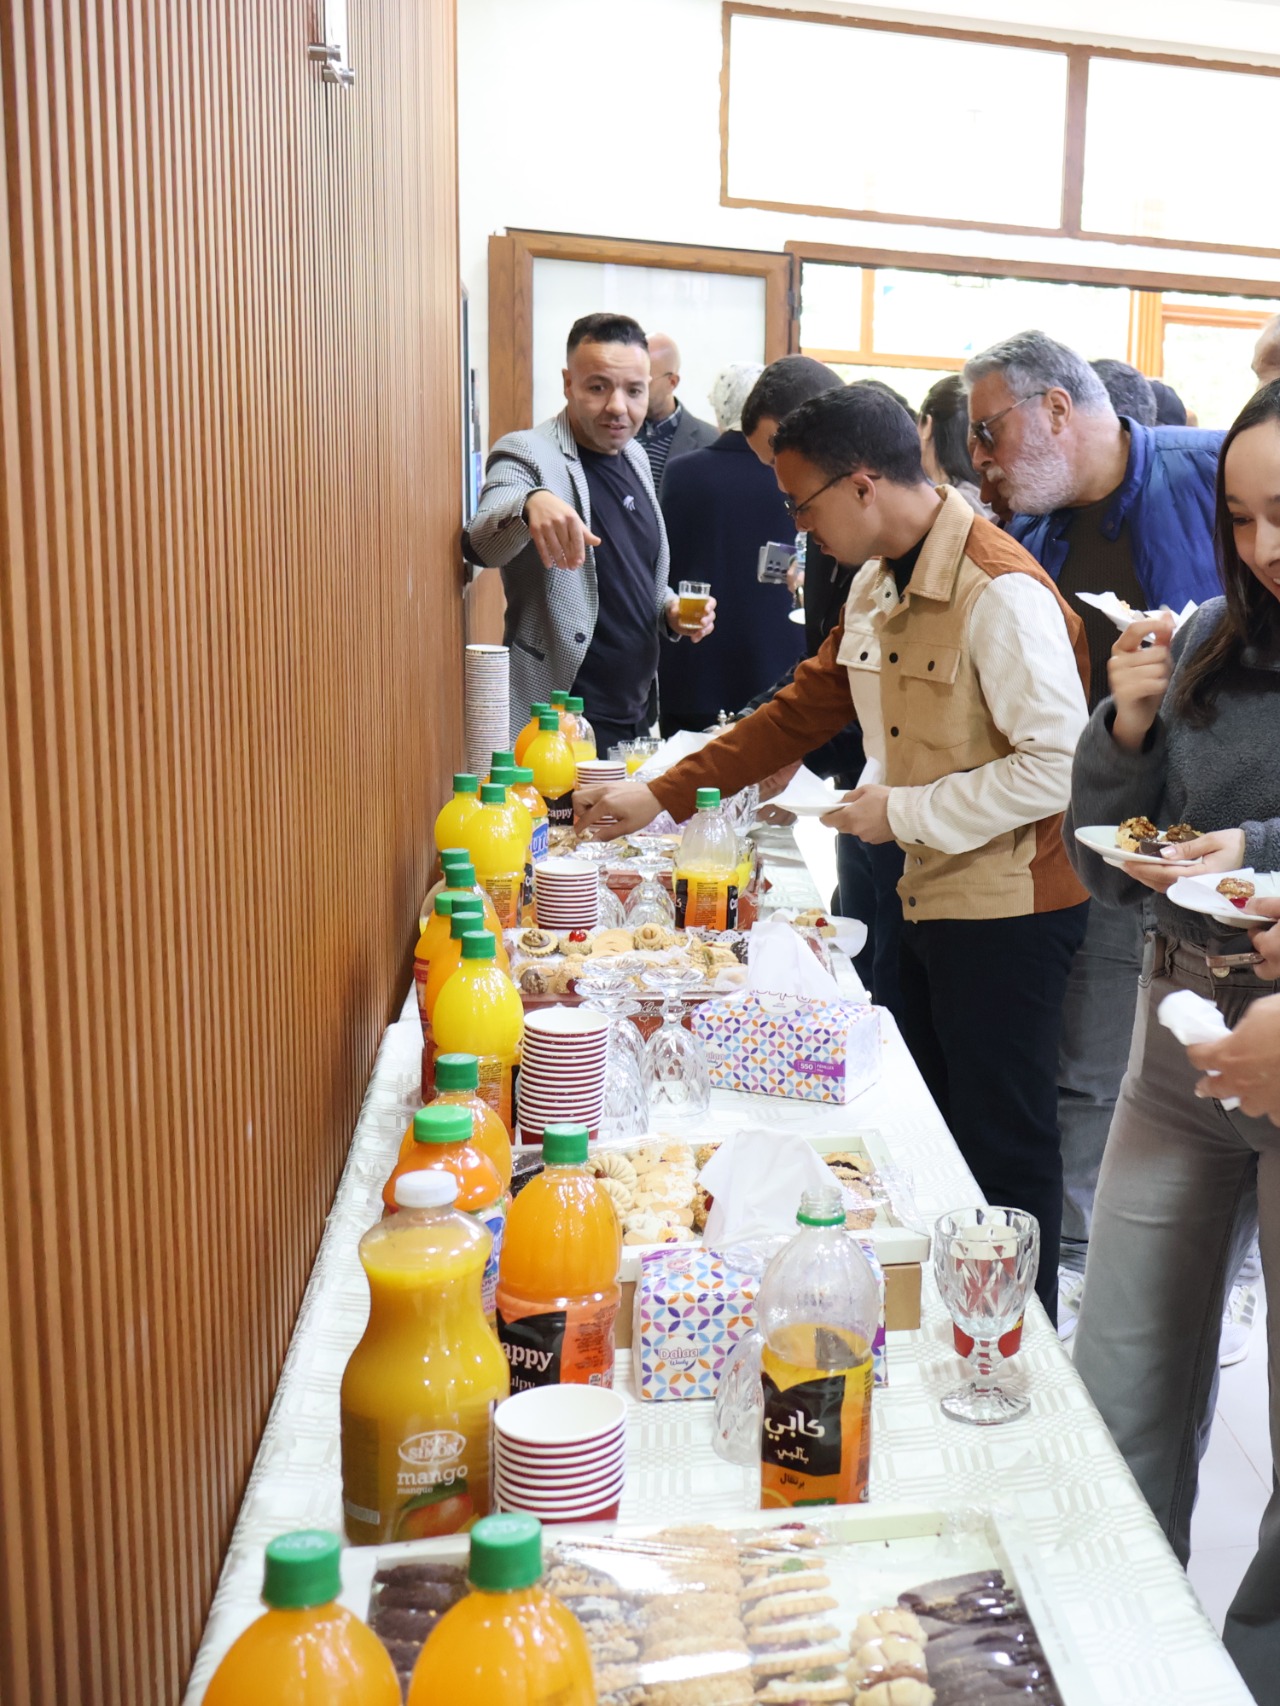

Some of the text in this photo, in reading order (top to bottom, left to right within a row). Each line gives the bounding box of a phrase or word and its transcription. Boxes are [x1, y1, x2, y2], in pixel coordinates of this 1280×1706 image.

[501, 1341, 554, 1372] appy
[660, 1347, 699, 1360] Dalaa
[510, 1375, 536, 1391] ulpy
[764, 1409, 826, 1441] كابي
[420, 1435, 447, 1448] DON
[408, 1442, 459, 1459] SIMON
[397, 1465, 468, 1486] mango
